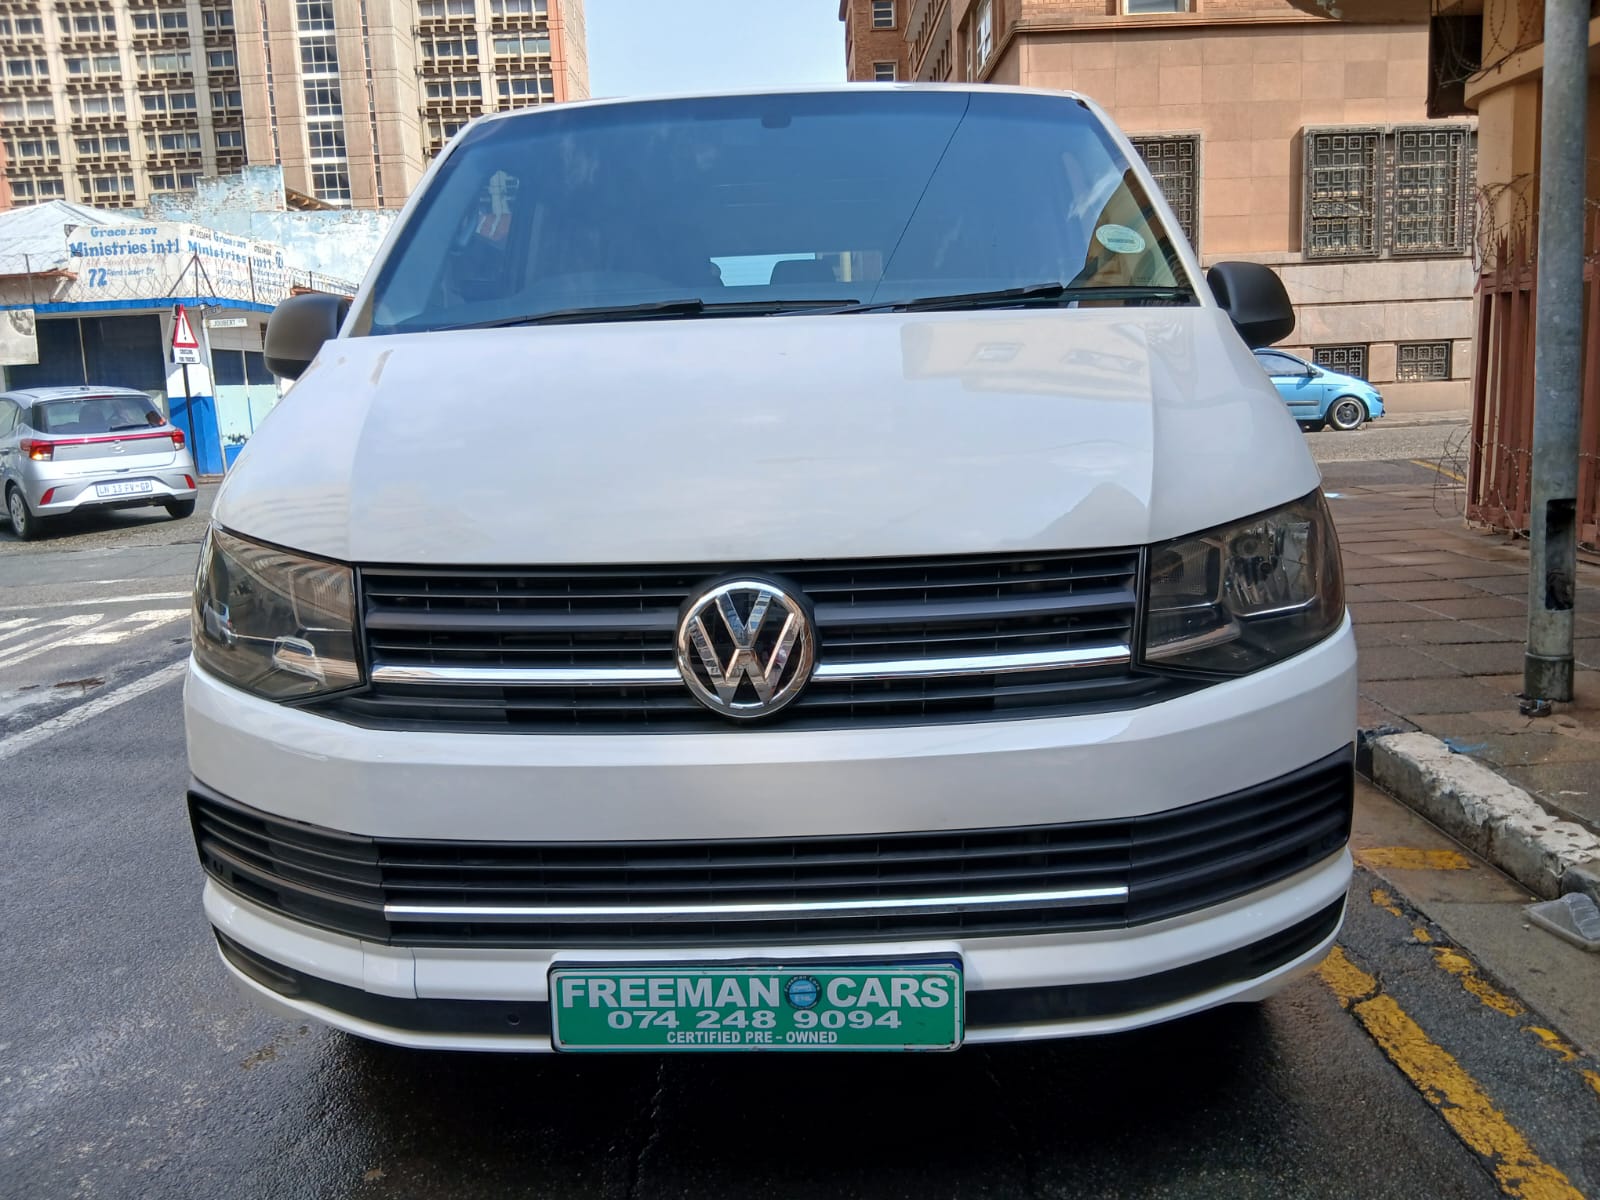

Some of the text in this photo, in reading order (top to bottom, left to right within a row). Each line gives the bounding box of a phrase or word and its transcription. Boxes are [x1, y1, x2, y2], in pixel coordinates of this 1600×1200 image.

[90, 226, 126, 238] Grace
[69, 240, 148, 258] Ministries
[187, 239, 247, 264] Ministries
[87, 267, 108, 288] 72
[561, 977, 780, 1008] FREEMAN
[826, 976, 950, 1008] CARS
[607, 1009, 902, 1029] 074 248 9094
[666, 1031, 741, 1044] CERTIFIED
[745, 1031, 773, 1043] PRE
[785, 1030, 838, 1043] OWNED
